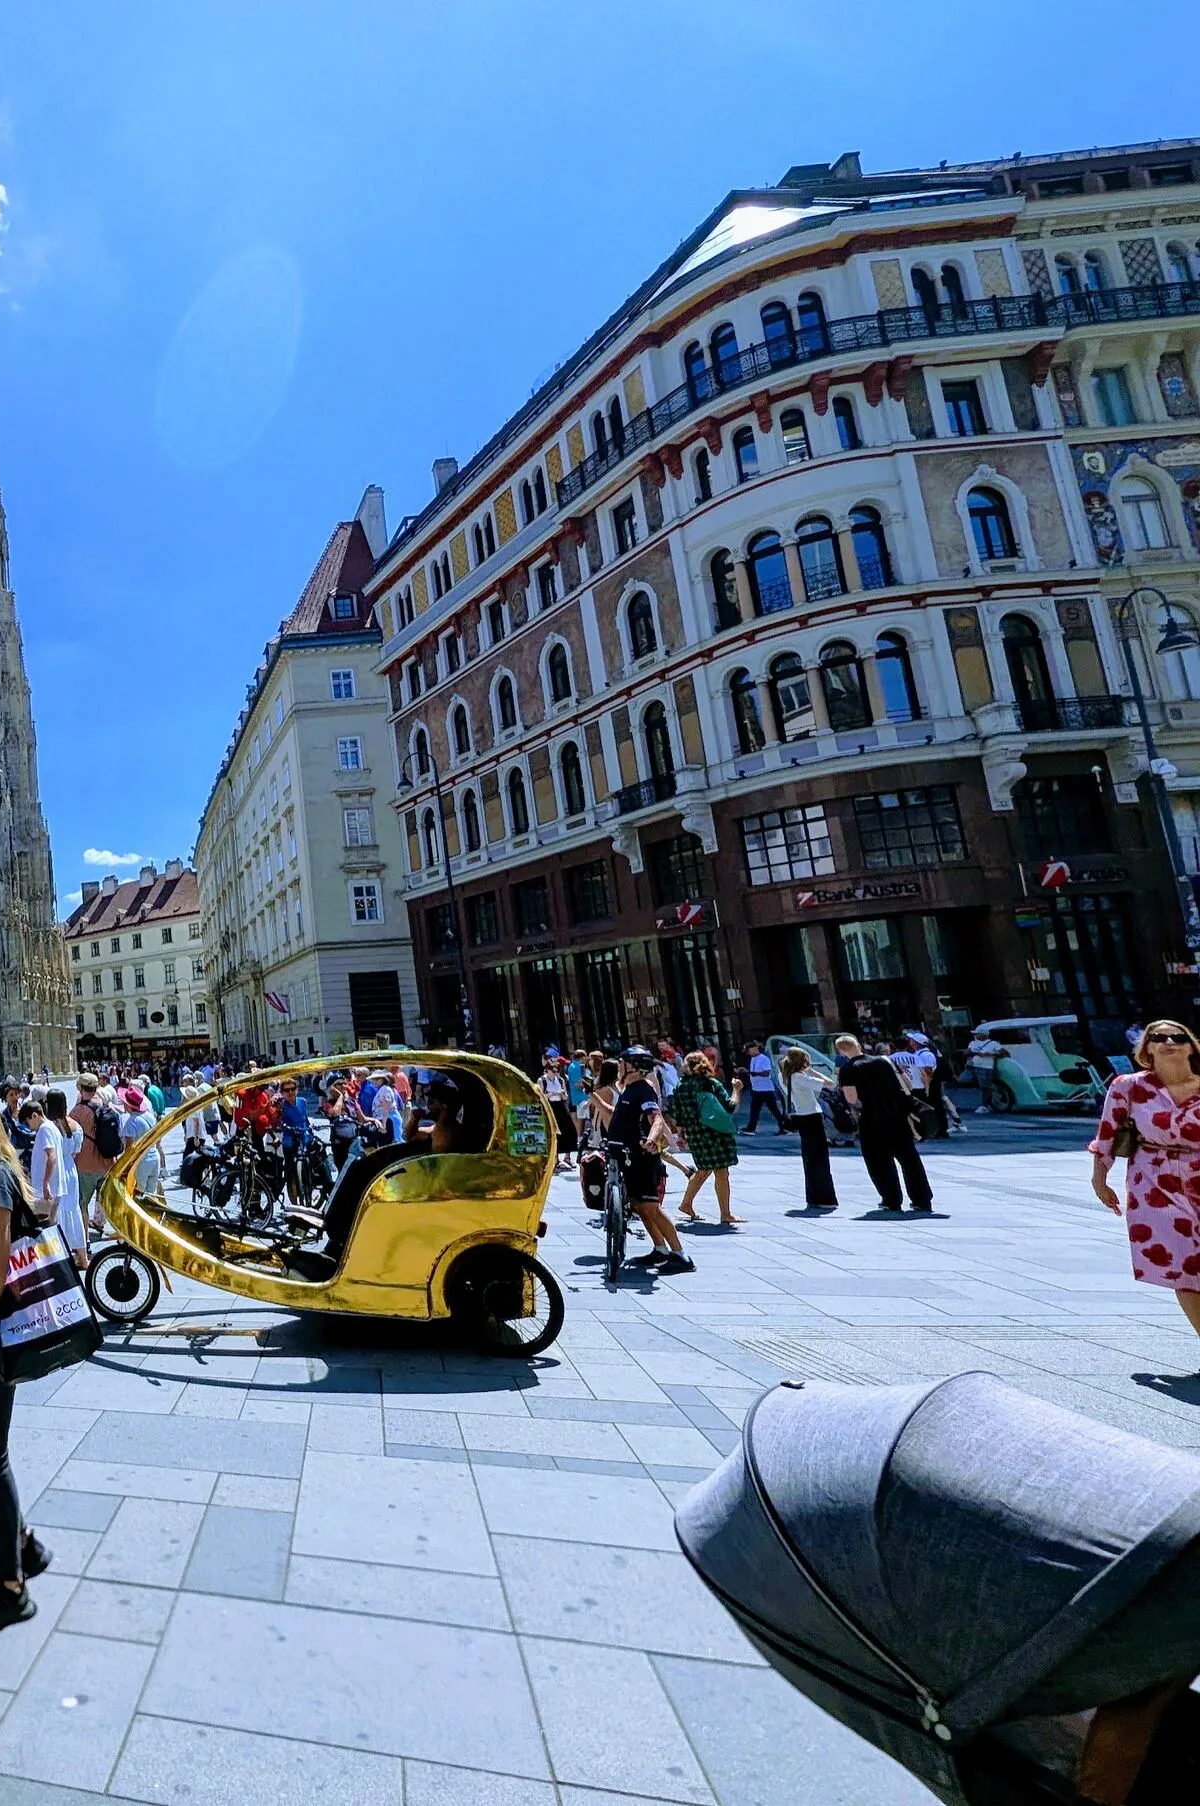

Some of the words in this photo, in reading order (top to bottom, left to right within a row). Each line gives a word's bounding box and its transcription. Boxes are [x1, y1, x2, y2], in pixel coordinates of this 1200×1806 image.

[816, 887, 857, 902] Bank
[862, 881, 921, 898] Austria
[55, 1298, 85, 1317] ecco
